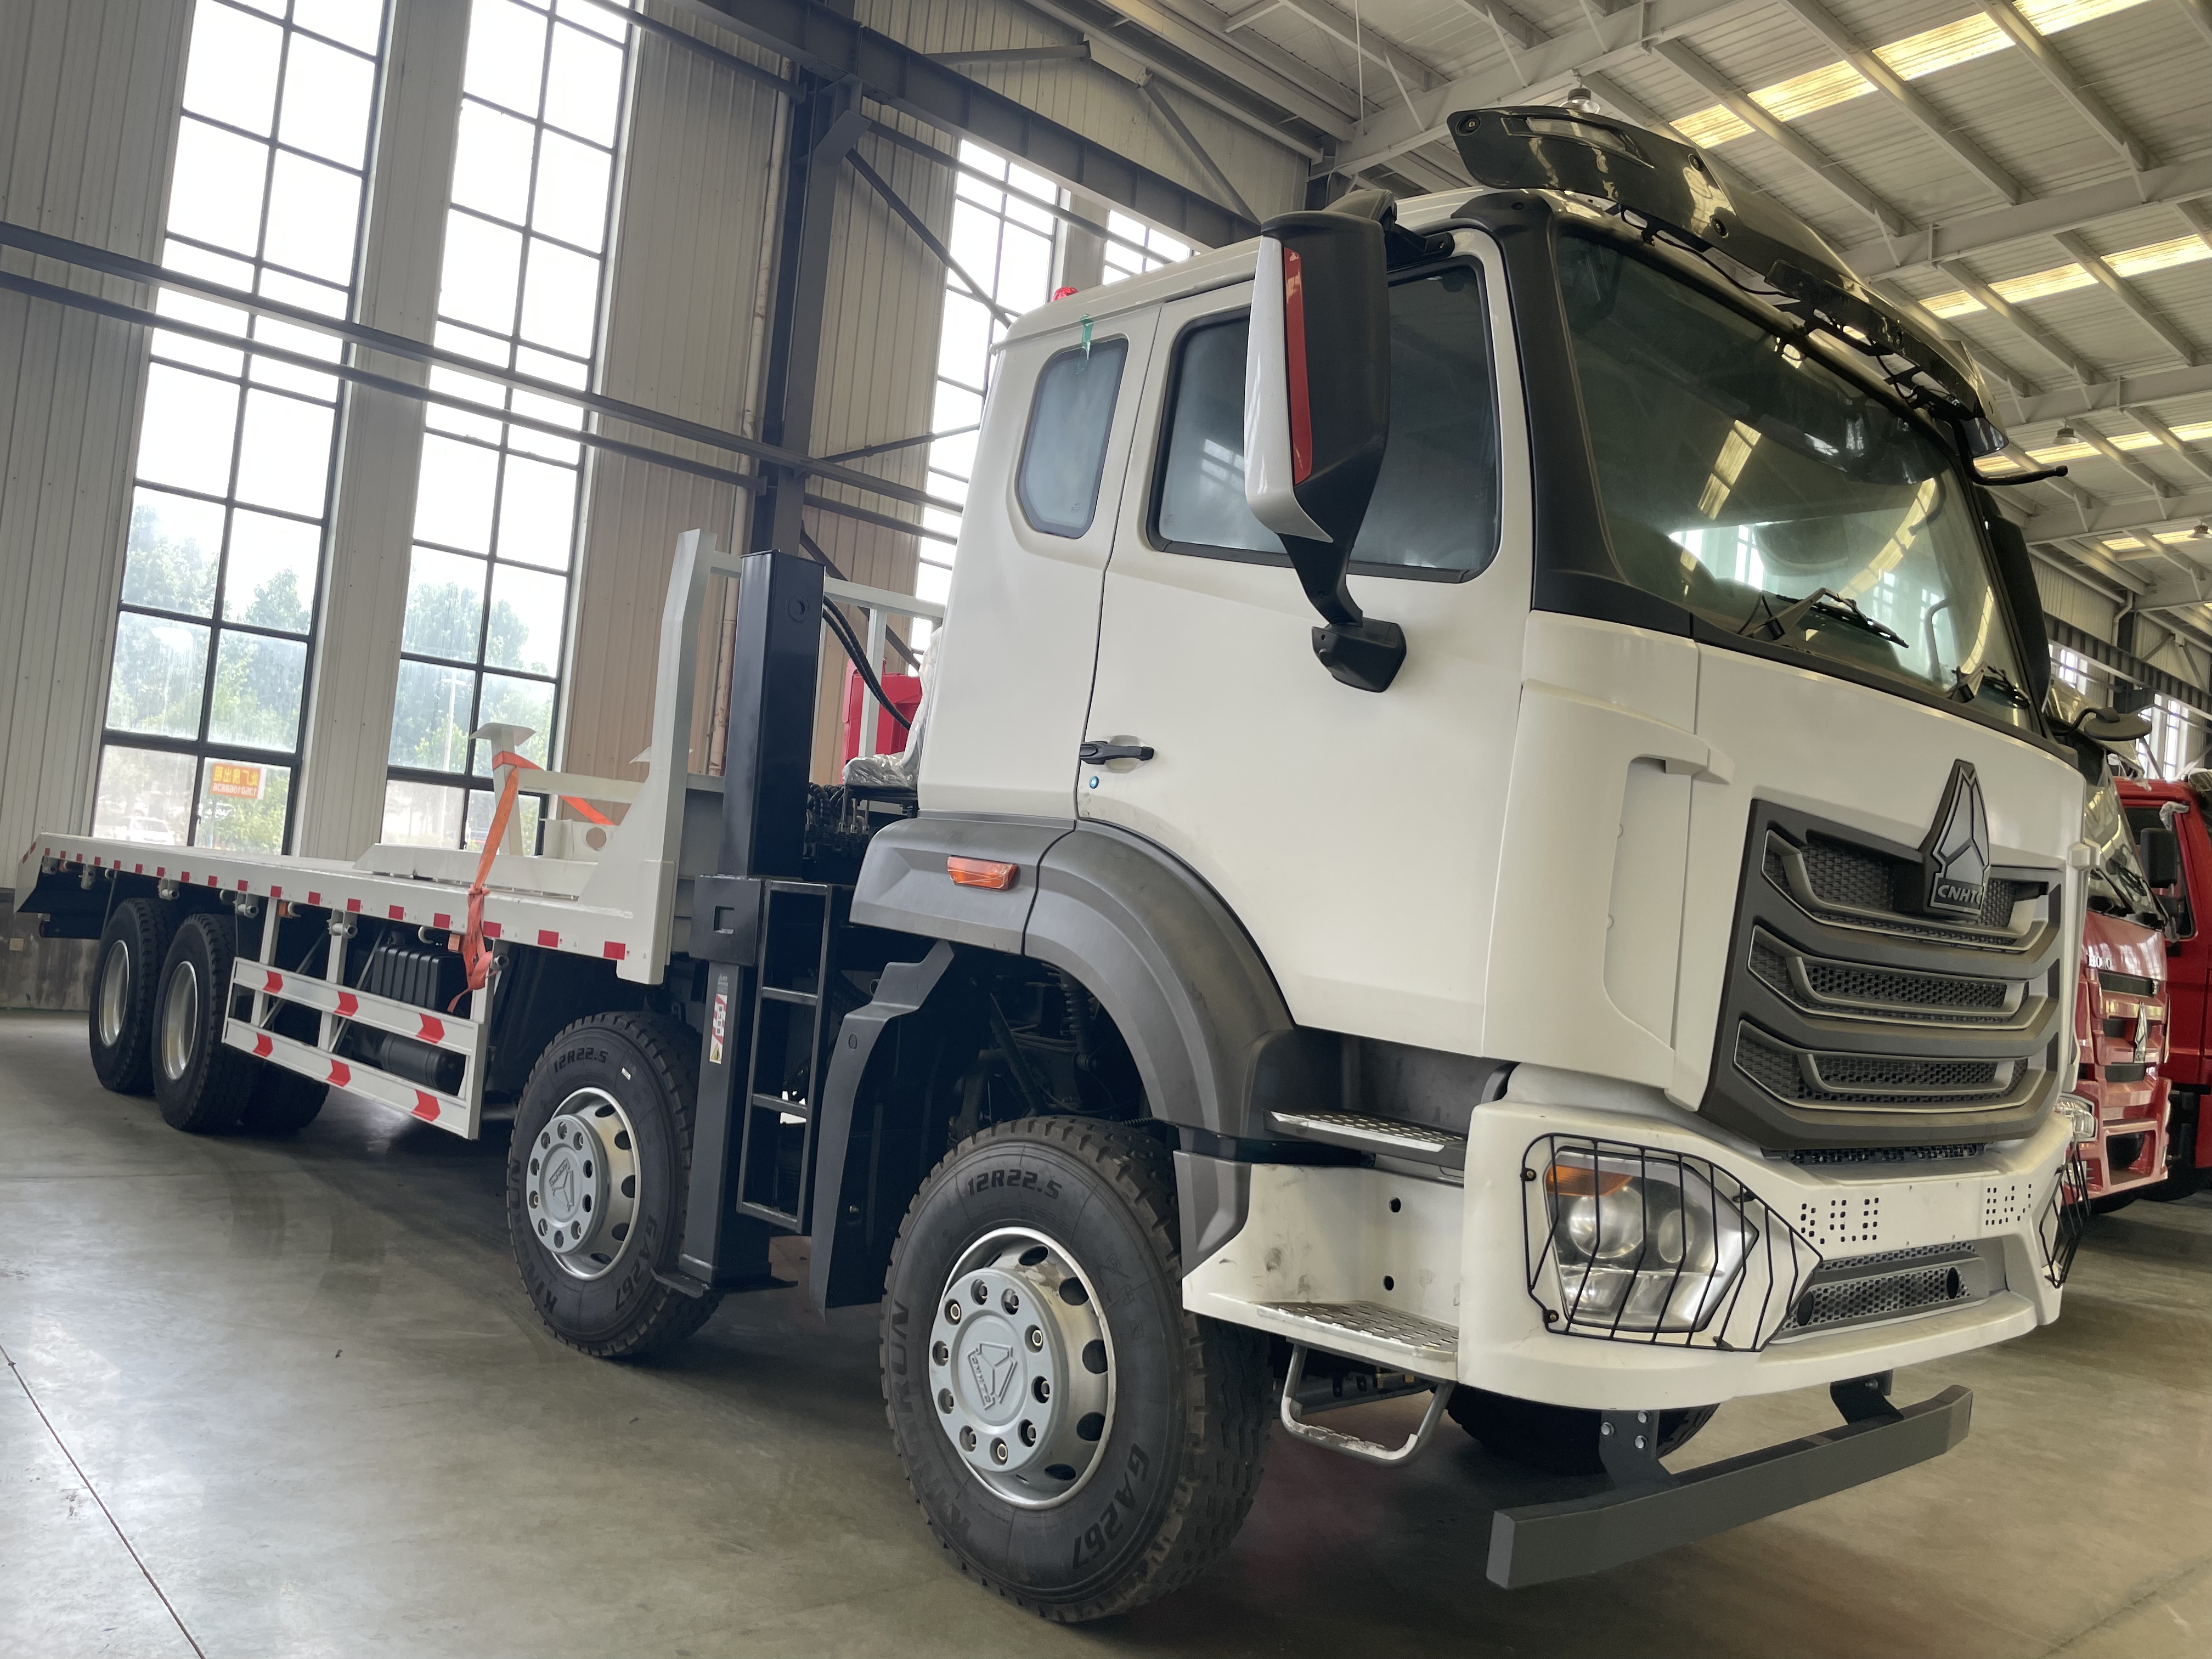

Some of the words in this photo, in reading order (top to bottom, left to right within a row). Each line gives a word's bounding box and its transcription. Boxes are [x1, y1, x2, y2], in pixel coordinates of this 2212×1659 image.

[554, 1047, 608, 1073] 12R22.5
[967, 1169, 1062, 1199] 12R22.5
[615, 1214, 658, 1311] GA267
[1073, 1442, 1150, 1570] GA267
